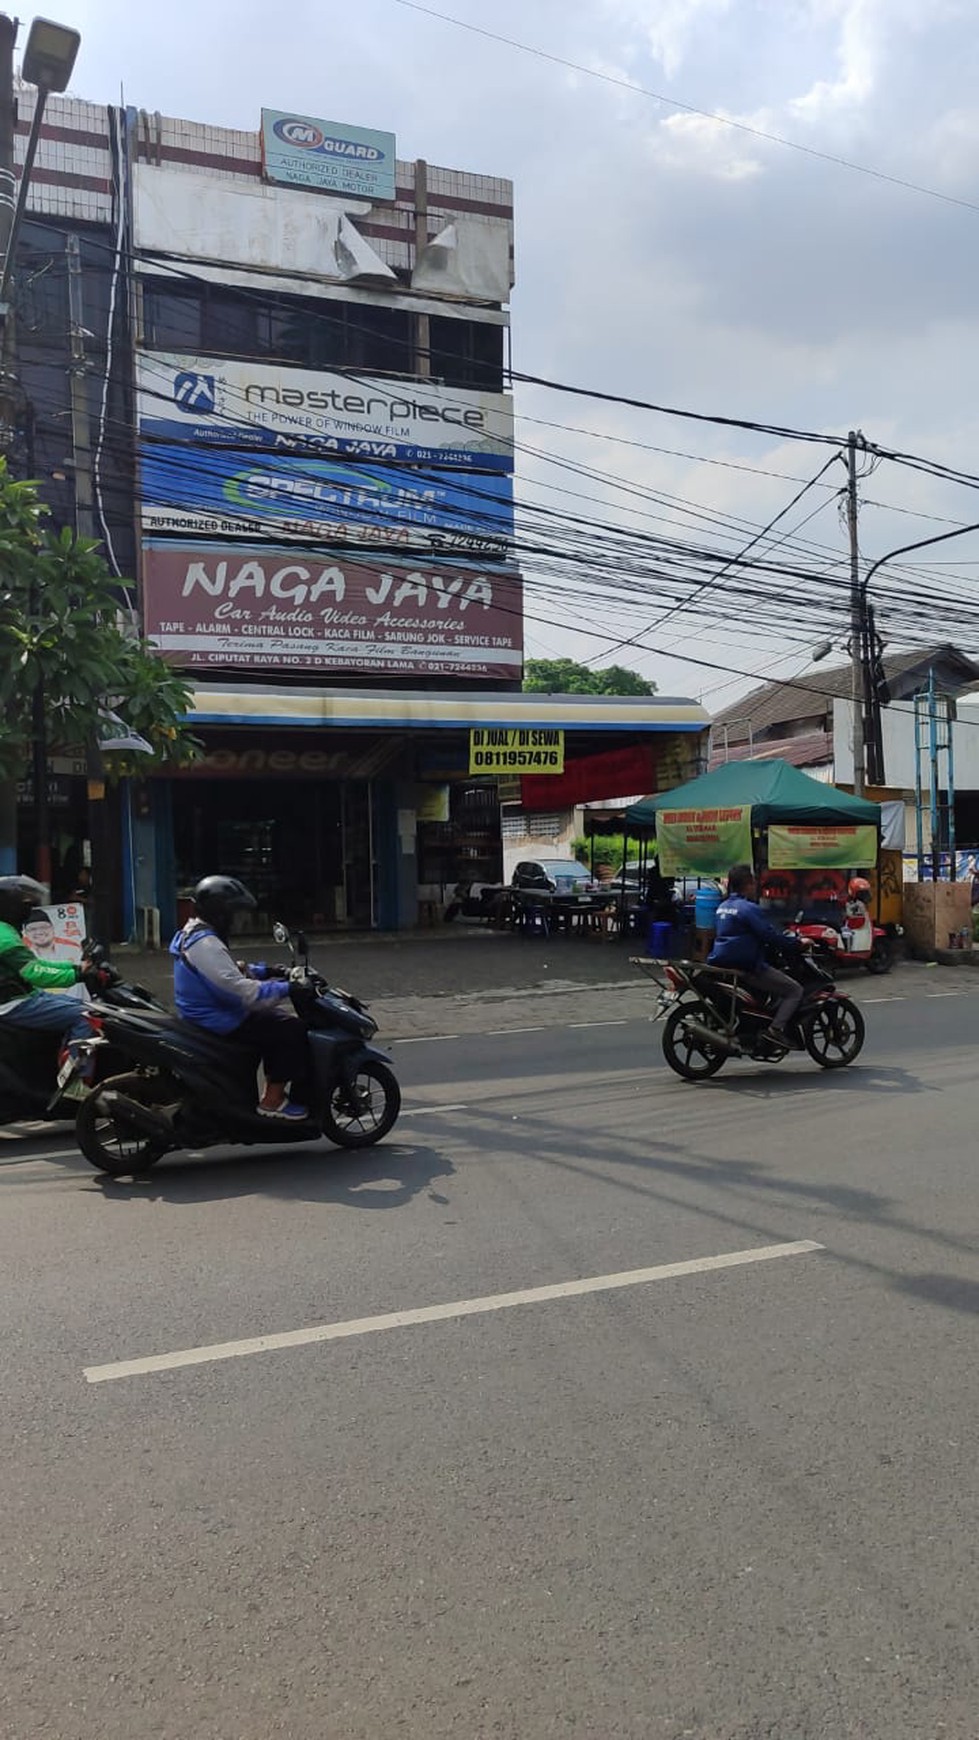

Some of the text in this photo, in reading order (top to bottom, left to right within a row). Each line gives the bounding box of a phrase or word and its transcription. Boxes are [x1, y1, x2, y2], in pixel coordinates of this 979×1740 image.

[324, 140, 378, 159] GUARD
[280, 159, 338, 175] AUTHORIZED
[342, 170, 378, 182] DEALER
[286, 172, 374, 194] NAGA JAYA MOTOR
[245, 384, 485, 428] masterpiece
[247, 411, 411, 437] THE POWER OF WINDOW FILM
[274, 433, 338, 452] NAGA
[345, 438, 397, 458] JAYA
[416, 449, 432, 460] 021
[247, 475, 436, 512] SPECTRUM
[150, 515, 218, 531] AUTHORIZED
[397, 510, 437, 524] FILM
[182, 561, 493, 611] NAGA JAYA
[214, 601, 466, 631] Car Audio Video Accessories
[159, 622, 185, 633] TAPE
[195, 624, 231, 634] ALARM
[241, 626, 286, 637] CENTRAL
[288, 627, 314, 638] LOCK
[324, 629, 350, 639] KACA
[353, 631, 375, 641] FILM
[385, 632, 424, 643] SARUNG
[427, 634, 445, 644] JOK
[454, 636, 489, 646] SERVICE
[492, 637, 512, 647] TAPE
[217, 638, 461, 658] Terima Pasang Kaca Film Bangunan
[191, 654, 203, 662] JL.
[208, 654, 251, 664] CIPUTAT
[254, 655, 281, 665] RAYA
[283, 656, 302, 665] NO.
[315, 657, 323, 666] D
[325, 658, 385, 669] KEBAYORAN
[387, 660, 415, 670] LAMA
[473, 730, 484, 746] DI
[487, 730, 509, 746] JUAL
[520, 730, 529, 746] DI
[532, 730, 559, 746] SEWA
[475, 751, 558, 766] 0811957476
